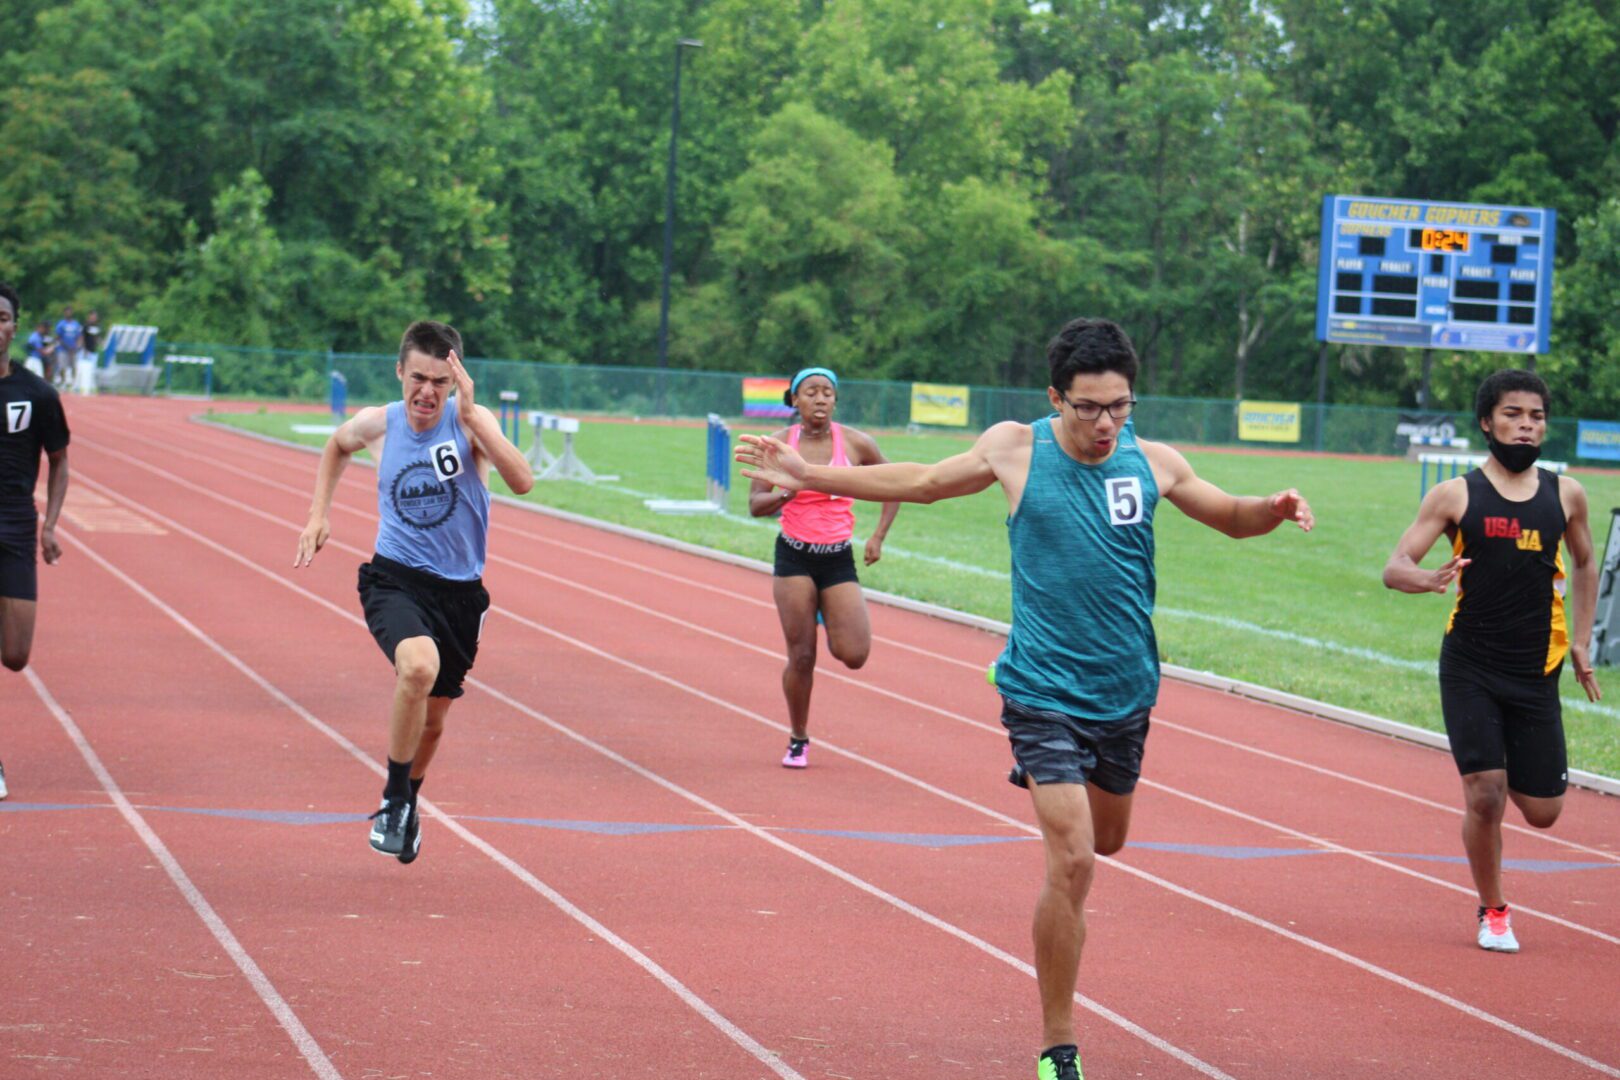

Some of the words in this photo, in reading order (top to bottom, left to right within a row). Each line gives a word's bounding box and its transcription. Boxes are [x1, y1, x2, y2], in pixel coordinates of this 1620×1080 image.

[1348, 202, 1420, 220] GOUCHER
[1425, 206, 1502, 225] GOPHERS
[1421, 228, 1469, 251] 0:24
[10, 405, 26, 430] 7
[436, 445, 459, 477] 6
[1112, 481, 1137, 520] 5
[1484, 516, 1523, 538] USA
[808, 542, 843, 554] NIKE
[1515, 528, 1543, 551] JA
